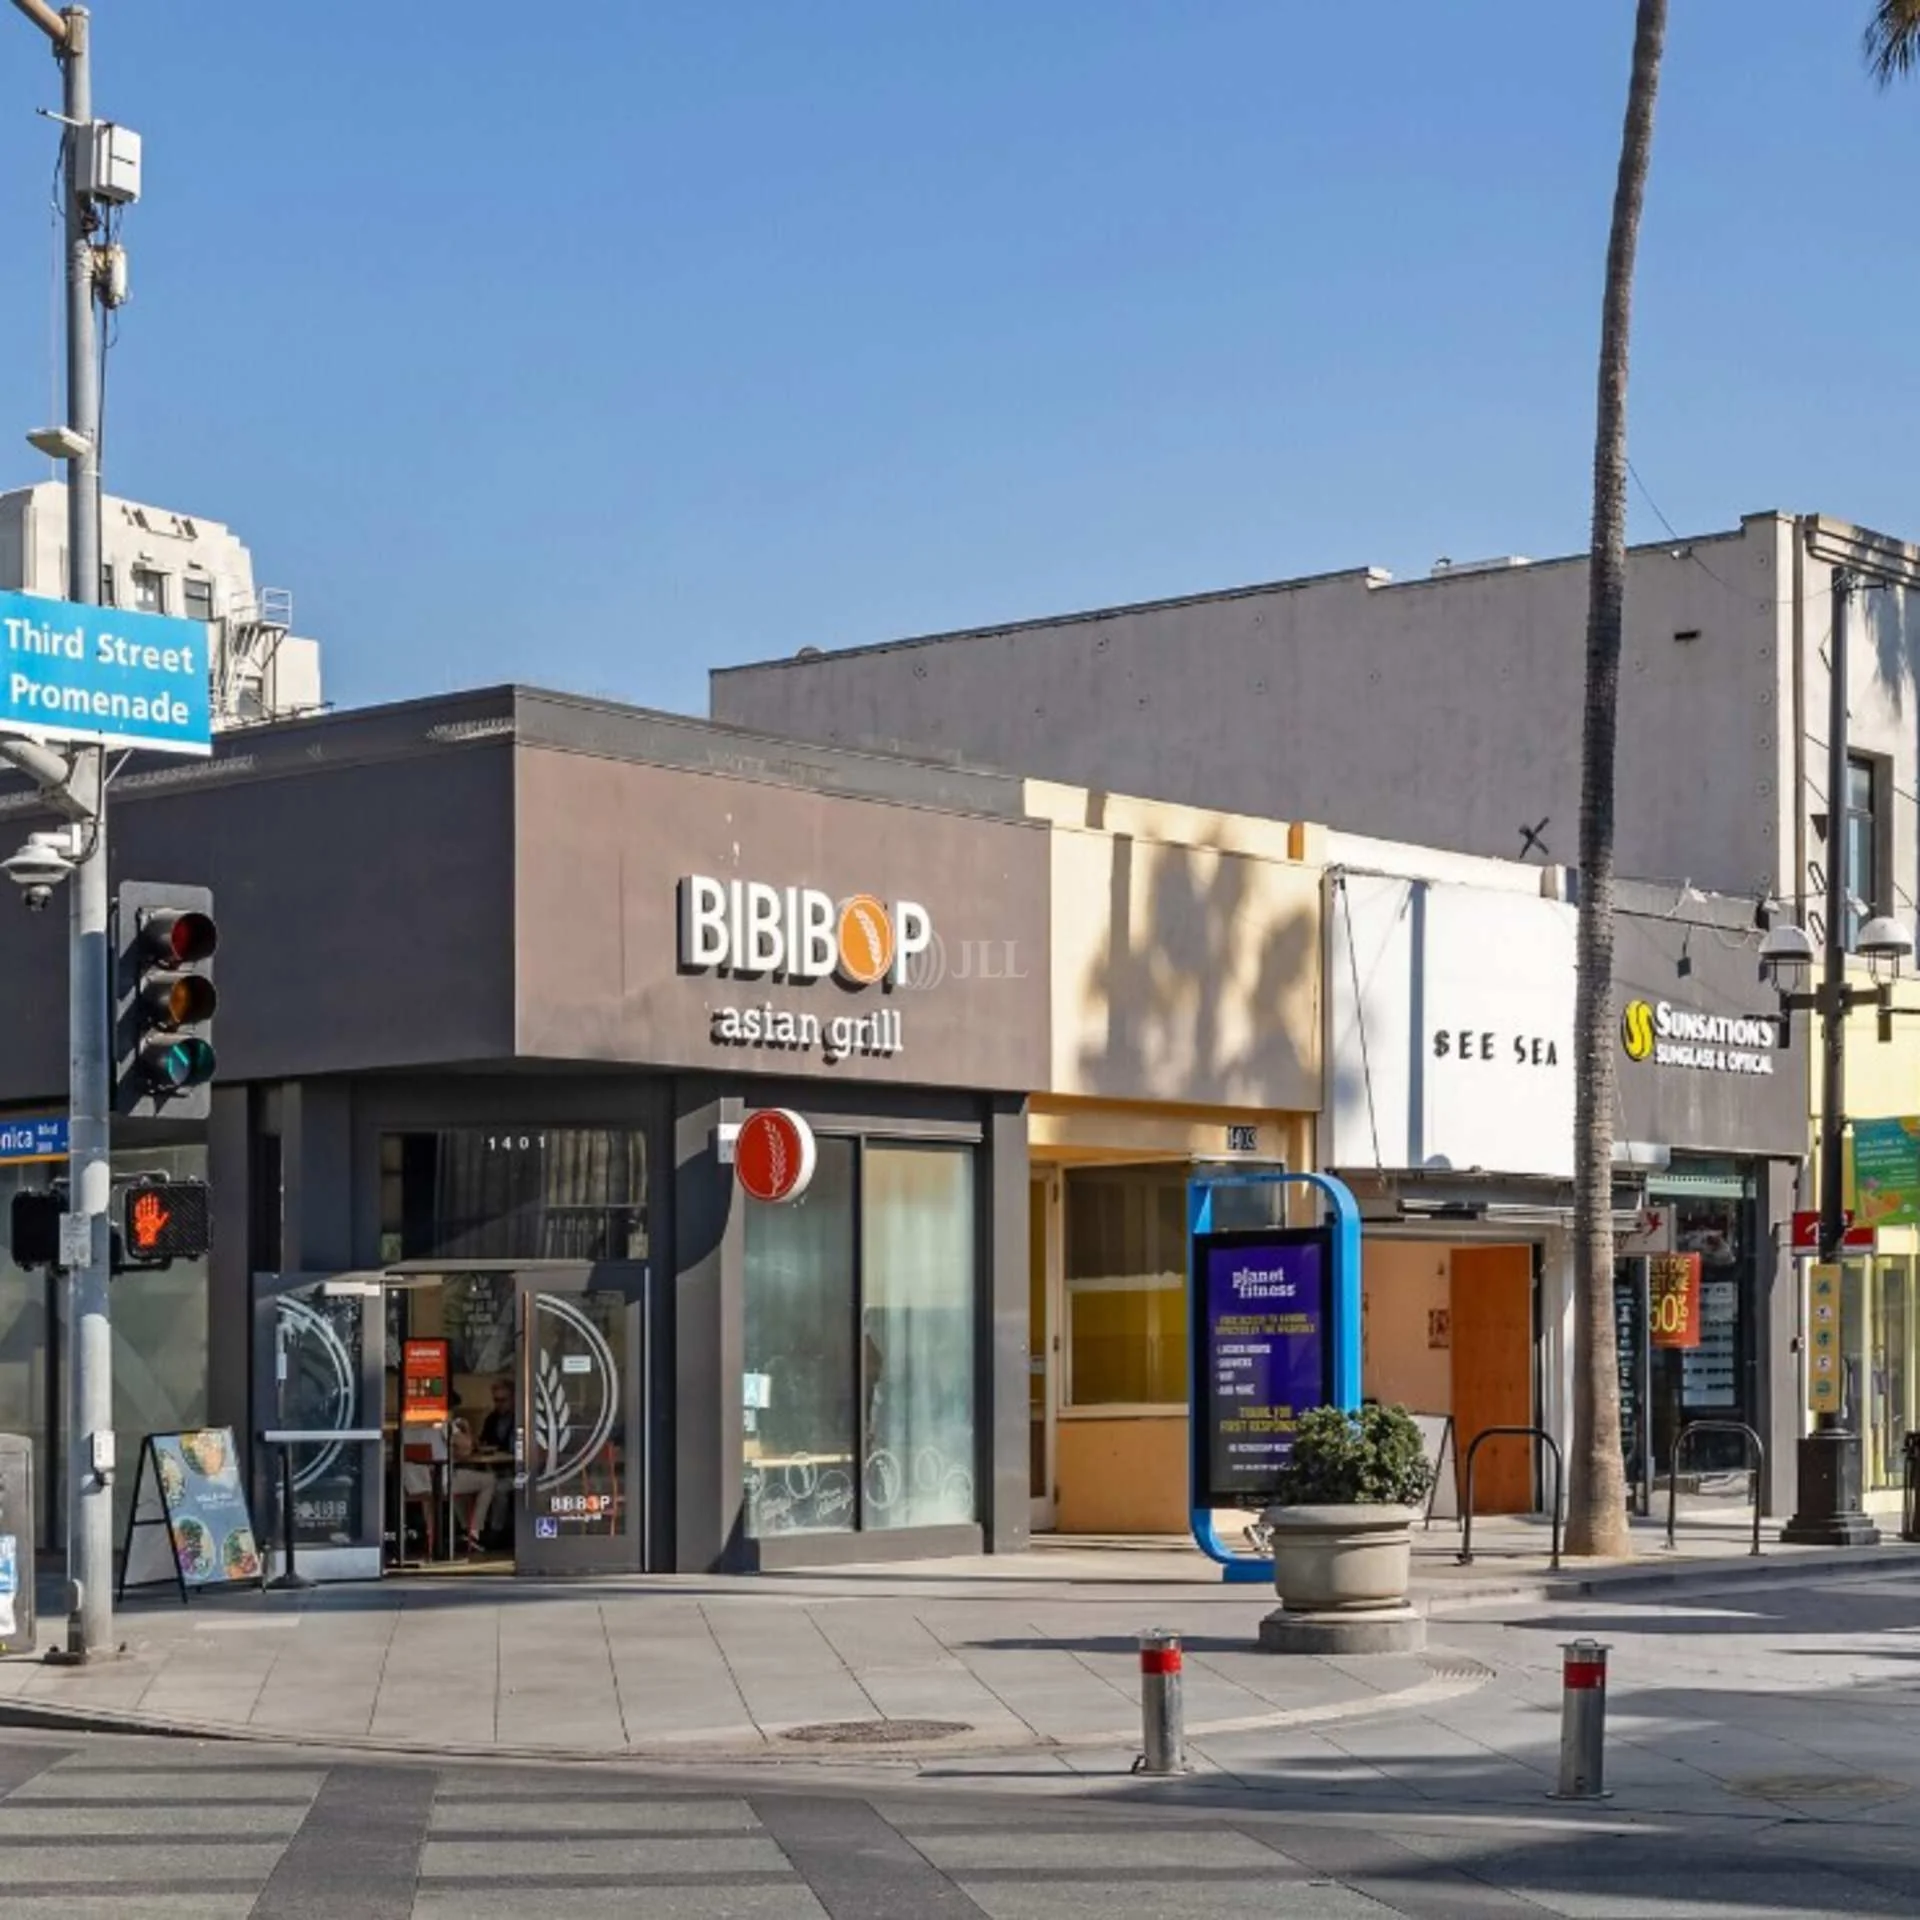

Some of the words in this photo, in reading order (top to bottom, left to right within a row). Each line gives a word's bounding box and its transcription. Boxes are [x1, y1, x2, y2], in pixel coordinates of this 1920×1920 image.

[4, 618, 84, 660] Third
[97, 633, 195, 675] Street
[10, 673, 189, 725] Promenade
[682, 873, 932, 986] BIBIBOP
[719, 1002, 822, 1045] asian
[831, 1008, 904, 1058] grill
[1433, 1029, 1495, 1060] SEE
[1513, 1034, 1558, 1066] SEA
[488, 1135, 545, 1151] 1401
[1232, 1266, 1284, 1289] planet
[1240, 1283, 1297, 1299] fitness
